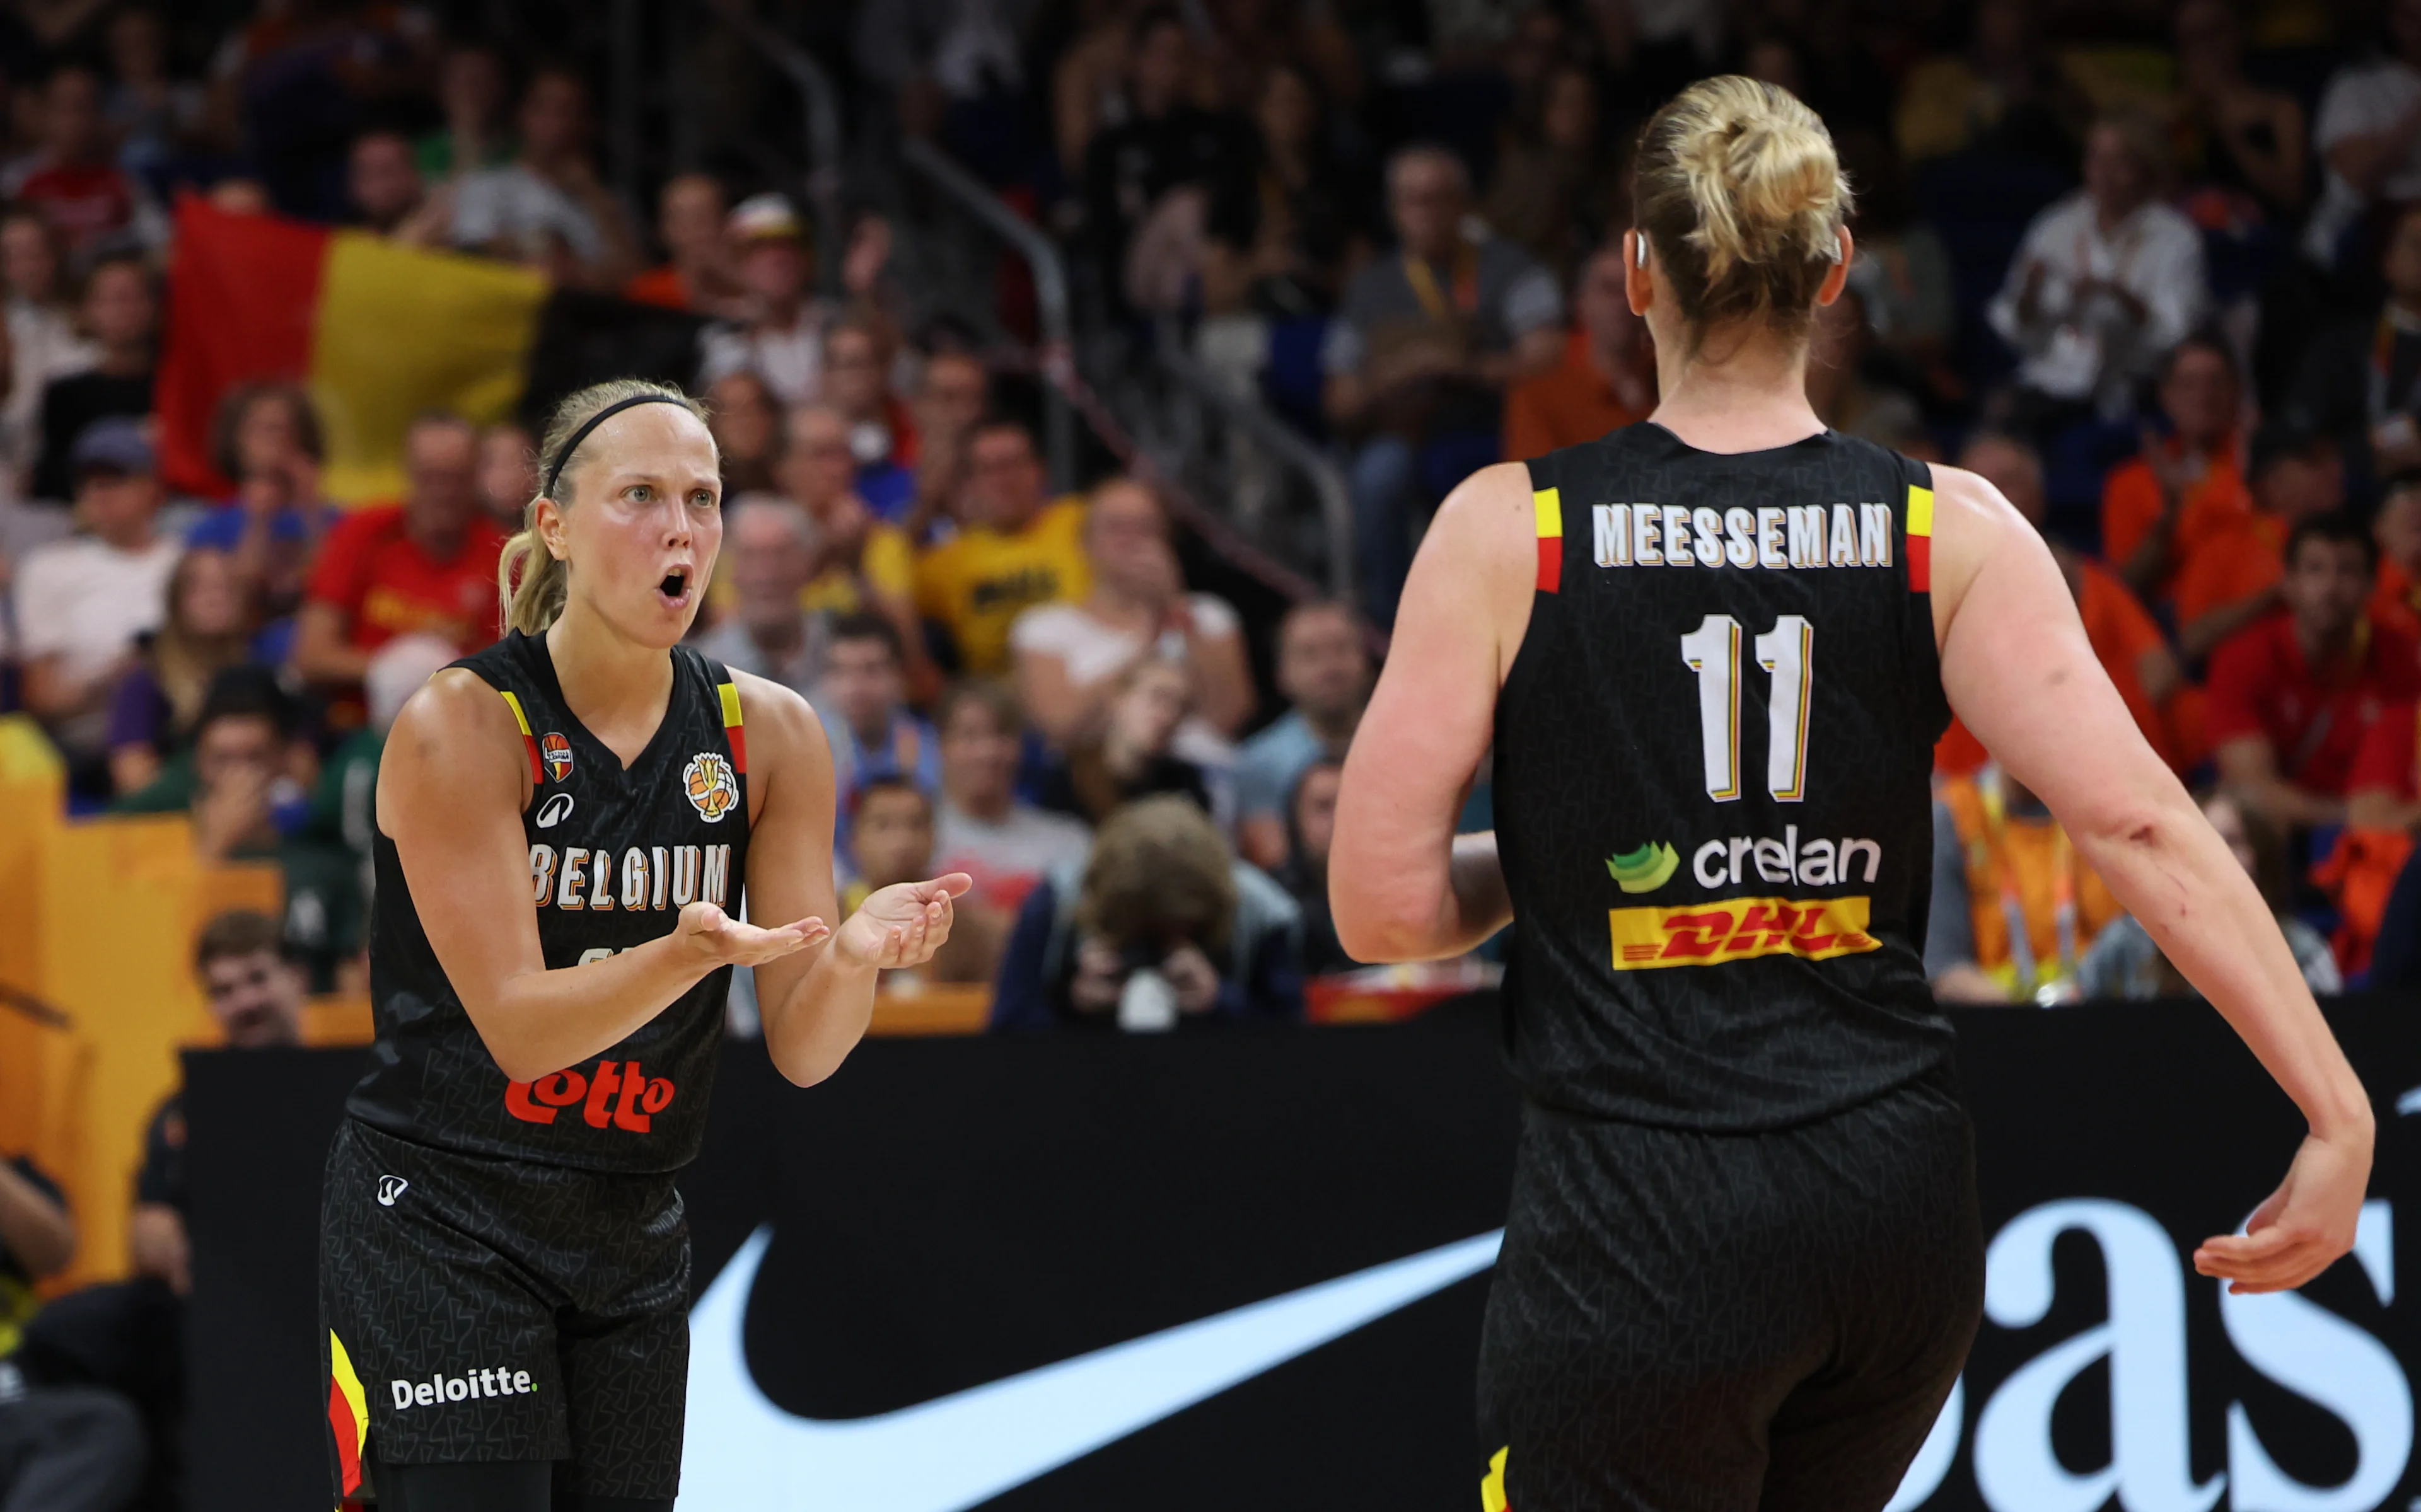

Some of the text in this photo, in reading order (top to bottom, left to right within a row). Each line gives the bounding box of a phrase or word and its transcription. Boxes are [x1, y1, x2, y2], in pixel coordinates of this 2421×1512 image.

[1592, 502, 1893, 569] MEESSEMAN
[1680, 613, 1814, 803] 11
[528, 843, 731, 911] BELGIUM
[1693, 824, 1882, 889] crelan
[1658, 905, 1839, 959] DHL
[504, 1059, 675, 1133] Lotto
[1881, 1084, 2421, 1512] as
[391, 1366, 538, 1410] Deloitte.
